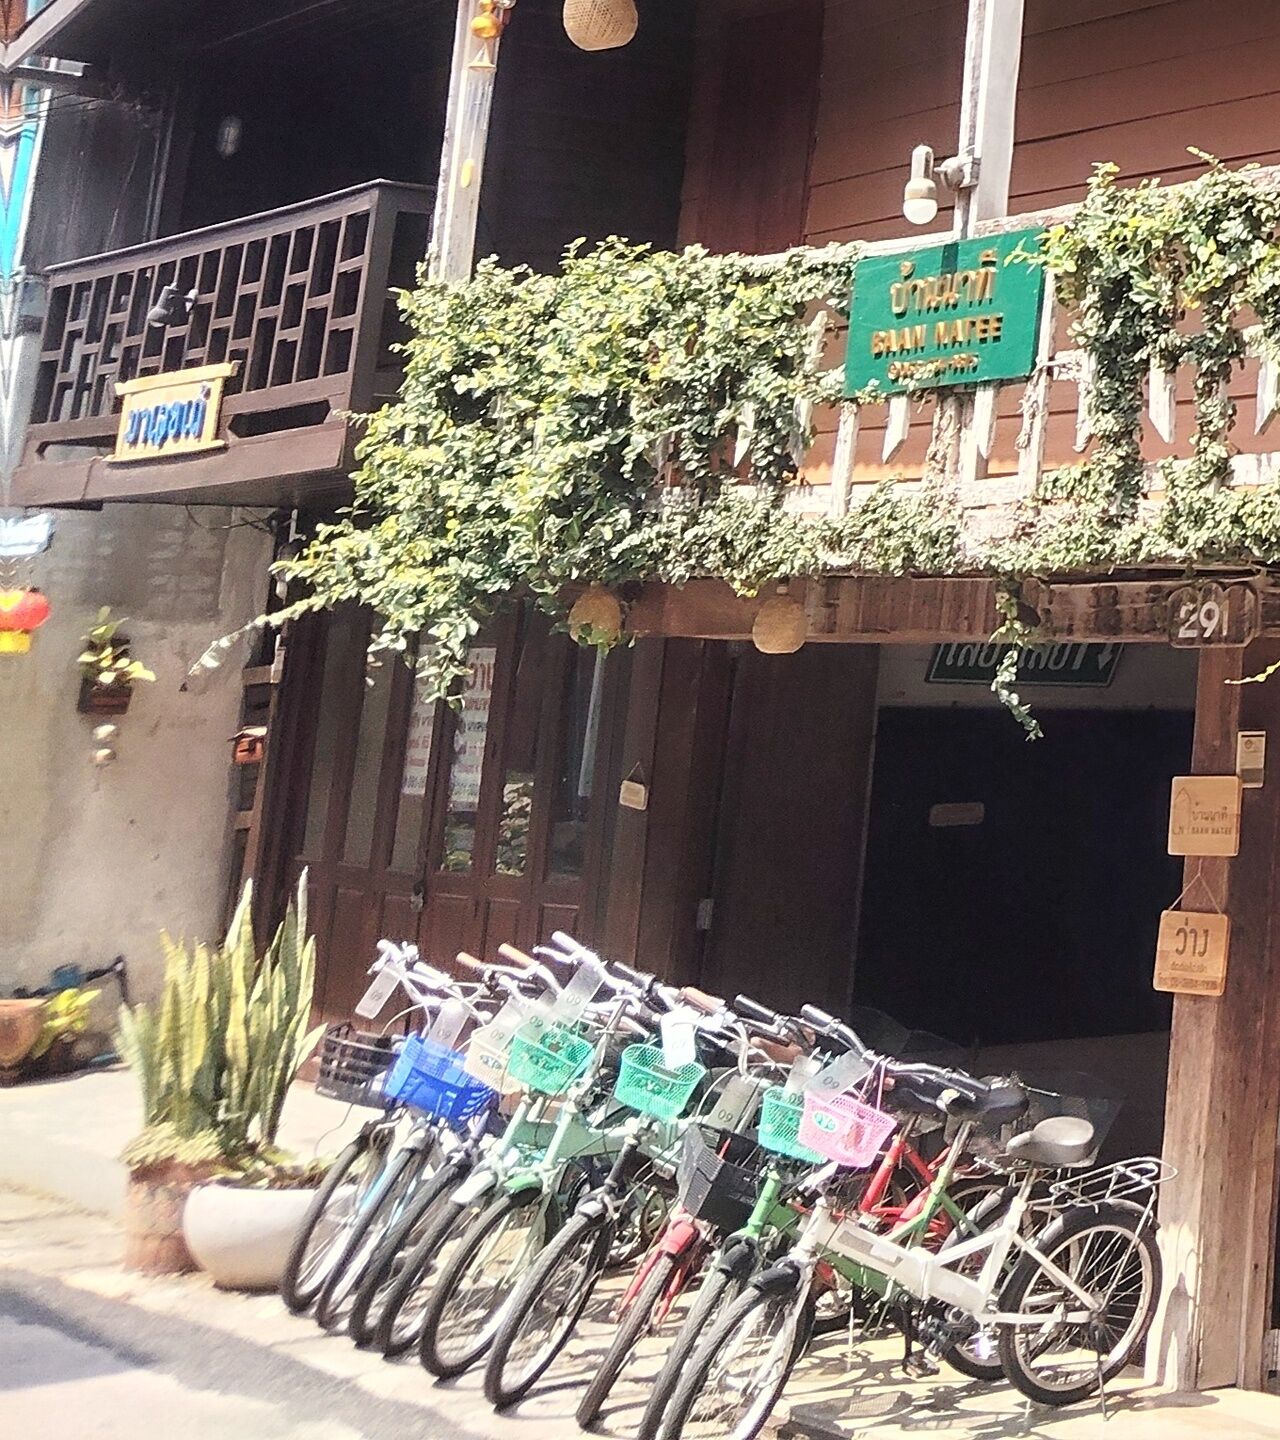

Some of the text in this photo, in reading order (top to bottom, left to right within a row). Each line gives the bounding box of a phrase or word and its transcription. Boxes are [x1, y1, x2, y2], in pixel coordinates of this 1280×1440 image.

[871, 313, 1003, 356] BAAN NATEE
[1177, 599, 1230, 639] 291
[1175, 917, 1209, 958] ว่าง
